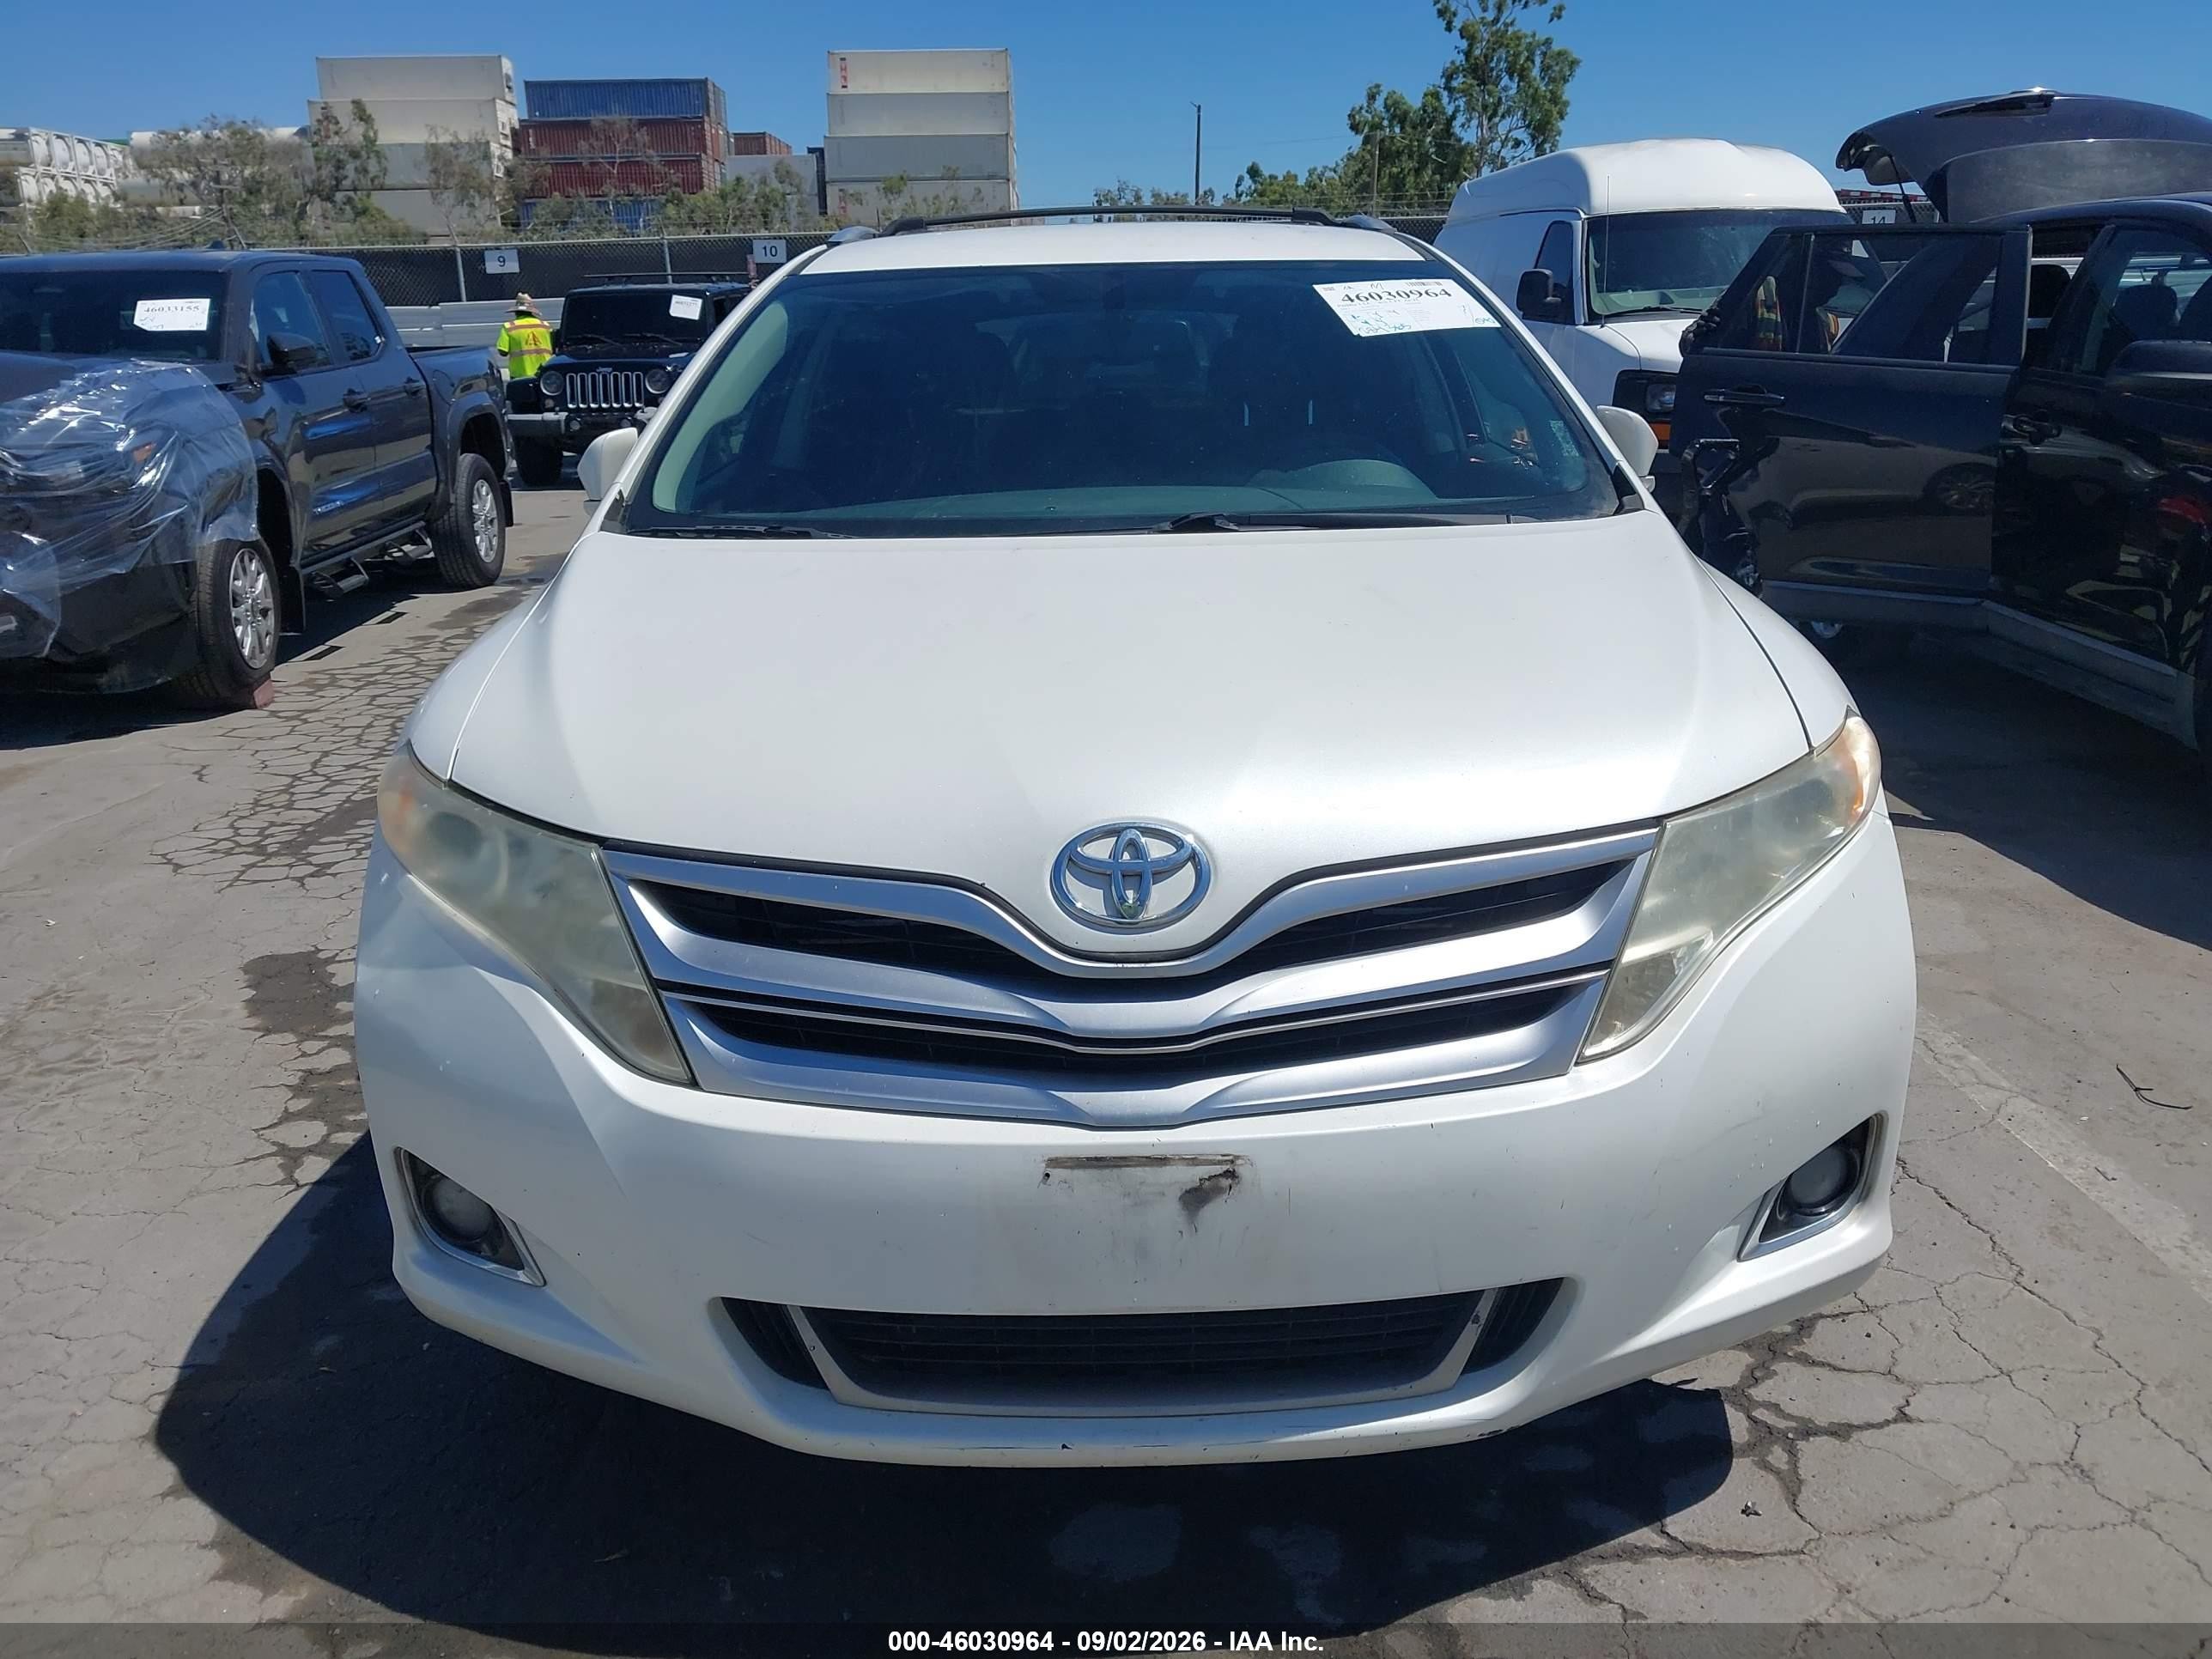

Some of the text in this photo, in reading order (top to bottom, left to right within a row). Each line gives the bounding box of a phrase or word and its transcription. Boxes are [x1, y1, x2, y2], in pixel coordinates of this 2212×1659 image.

[762, 245, 778, 257] 10
[496, 255, 506, 267] 9
[1341, 288, 1453, 303] 46030964
